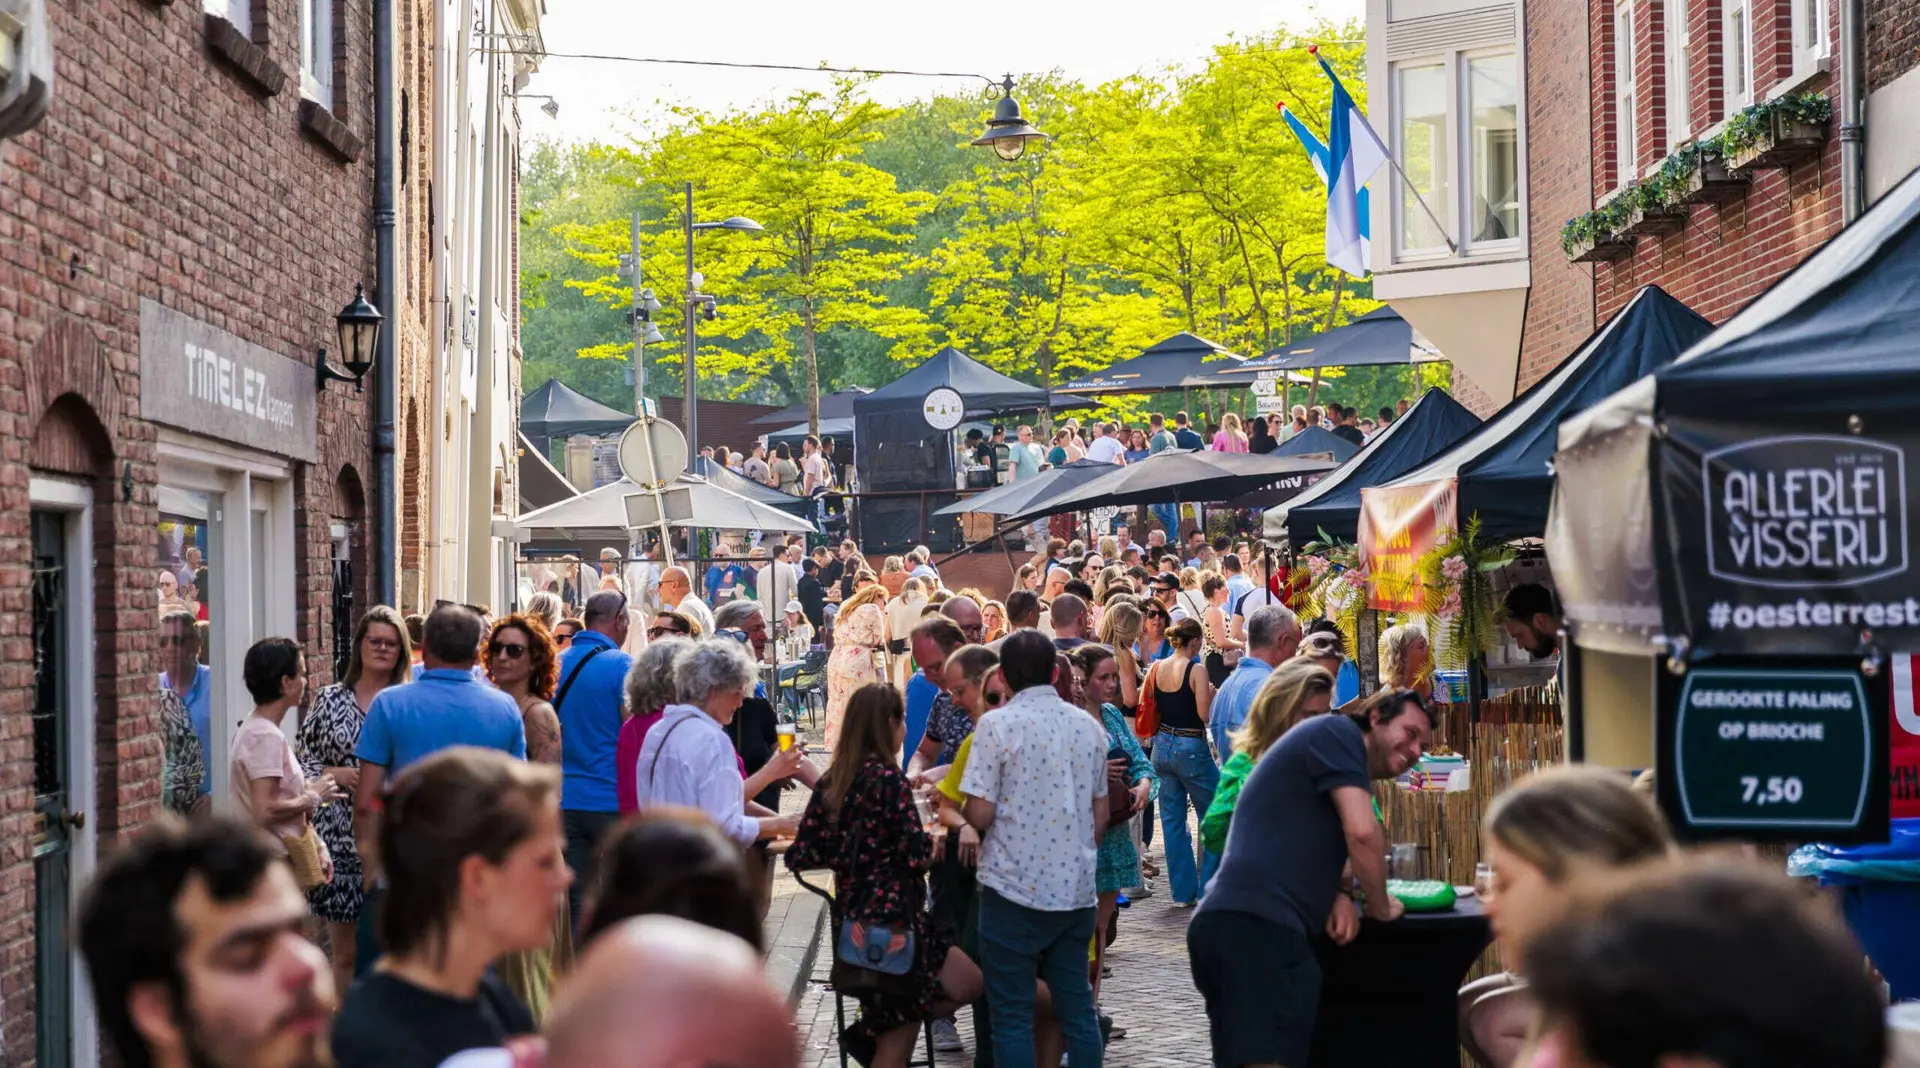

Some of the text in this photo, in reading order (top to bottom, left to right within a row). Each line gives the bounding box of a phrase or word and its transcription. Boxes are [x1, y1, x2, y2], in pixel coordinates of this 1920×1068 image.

[184, 342, 267, 420] TIMELEZ
[1723, 466, 1887, 518] ALLERLEI
[1728, 518, 1888, 569] VISSERIJ
[1708, 598, 1920, 630] #oesterrest
[1691, 690, 1853, 709] GEROOKTE PALING
[1718, 721, 1824, 741] OP BRIOCHE
[1740, 776, 1804, 806] 7,50
